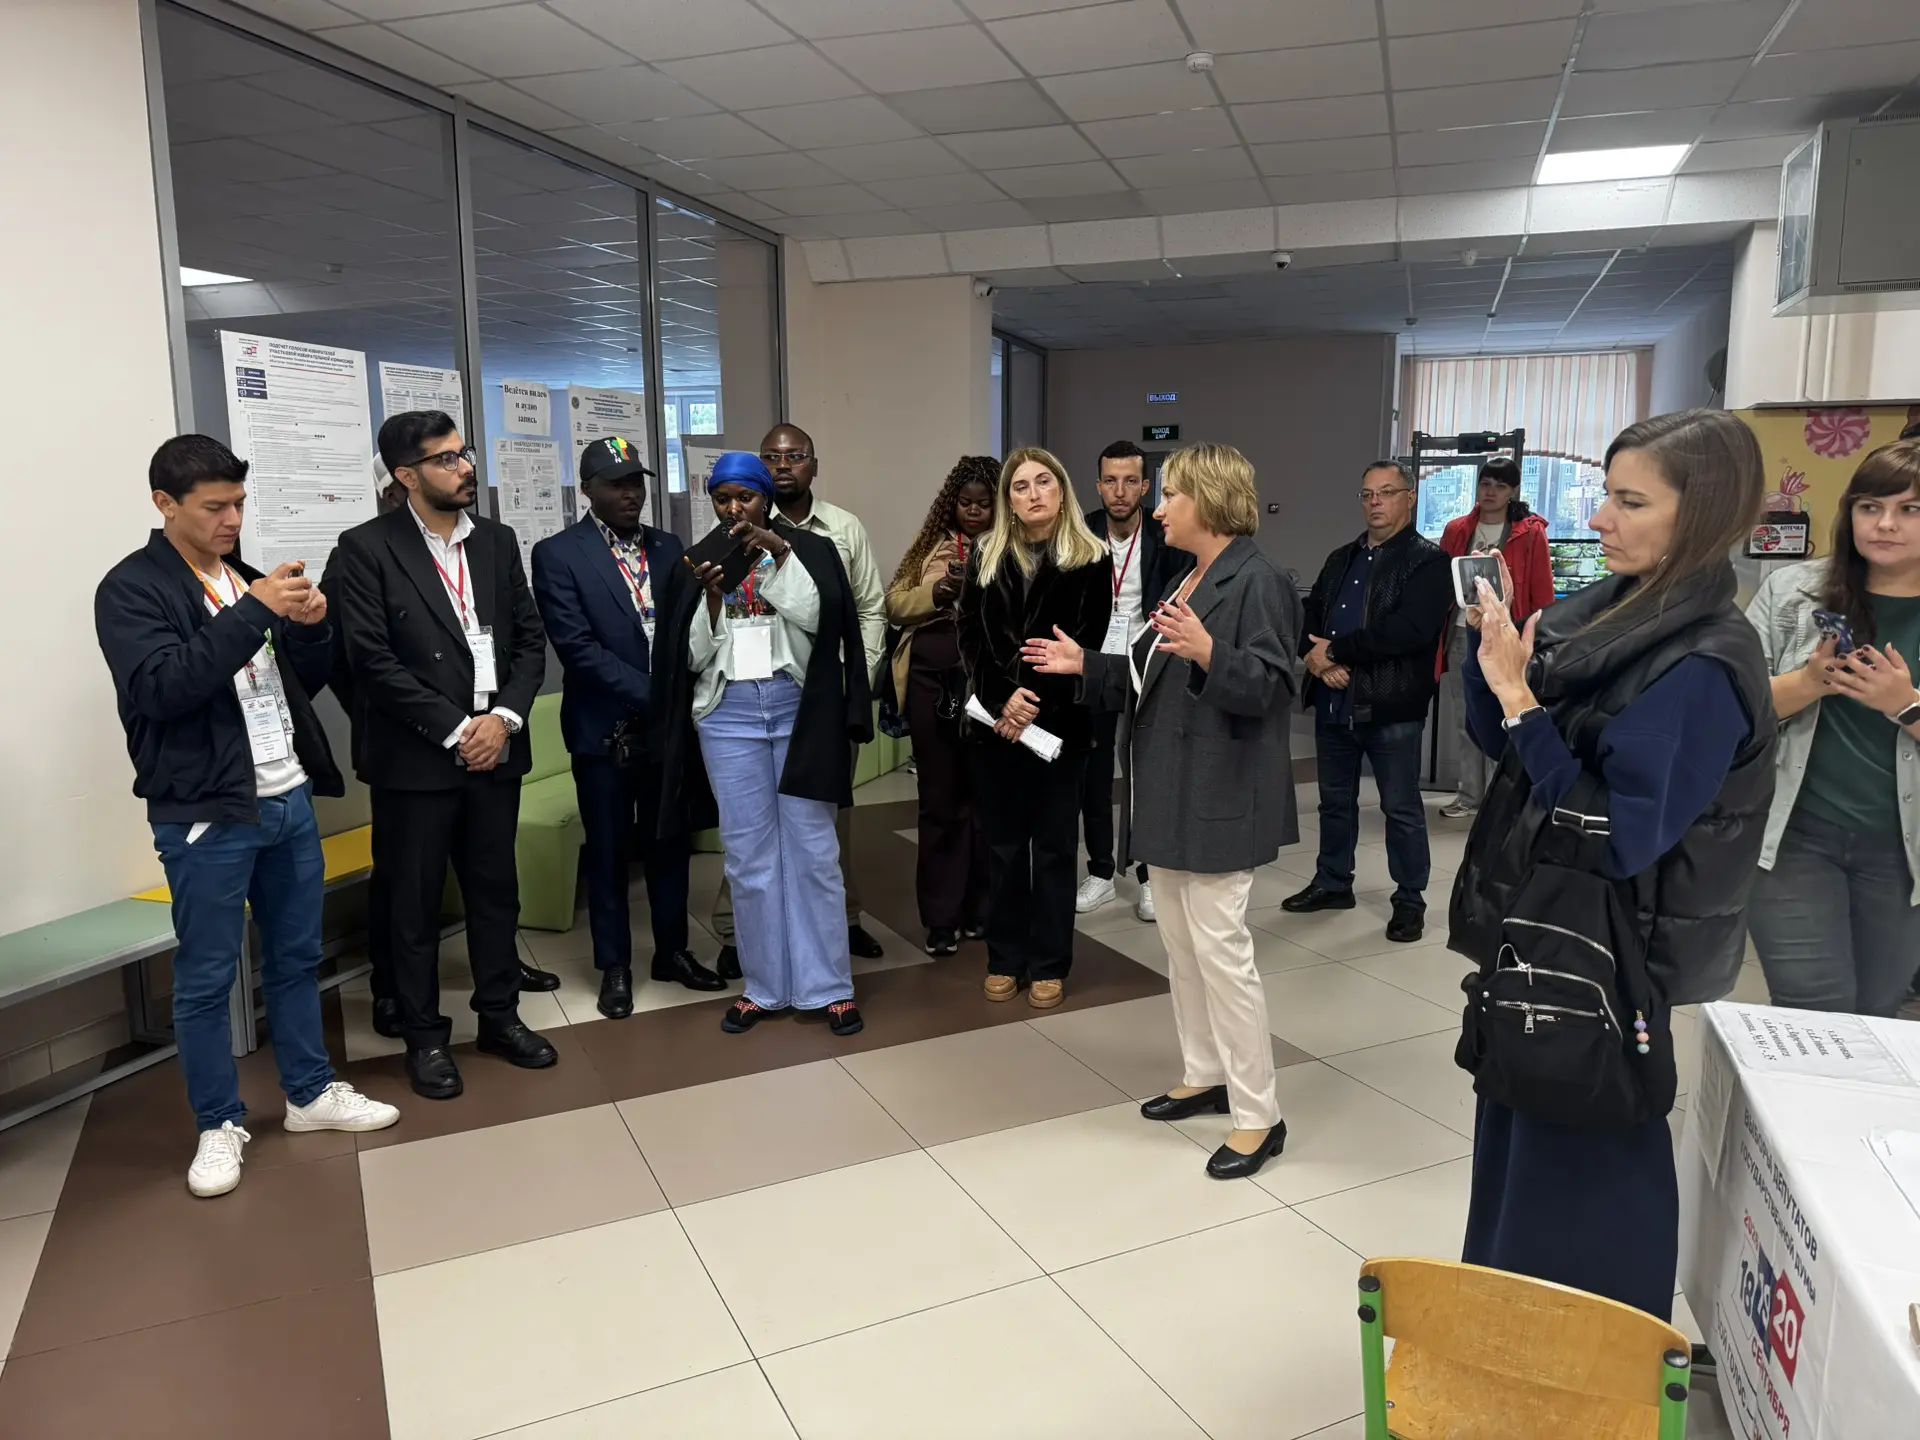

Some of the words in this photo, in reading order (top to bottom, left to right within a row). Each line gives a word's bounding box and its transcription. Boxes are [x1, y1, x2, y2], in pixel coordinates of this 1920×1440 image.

[504, 384, 528, 396] Ведётся
[518, 416, 538, 424] запись
[521, 402, 538, 412] аудио
[1741, 1139, 1795, 1260] ГОСУДАРСТВЕННОЙ
[1794, 1252, 1816, 1306] ДУМЫ
[1744, 1106, 1773, 1174] ВЫБОРЫ
[1773, 1162, 1817, 1261] ДЕПУТАТОВ
[1741, 1260, 1755, 1317] 18
[1773, 1288, 1798, 1359] 20
[1752, 1336, 1790, 1439] СЕНТЯБРЯ
